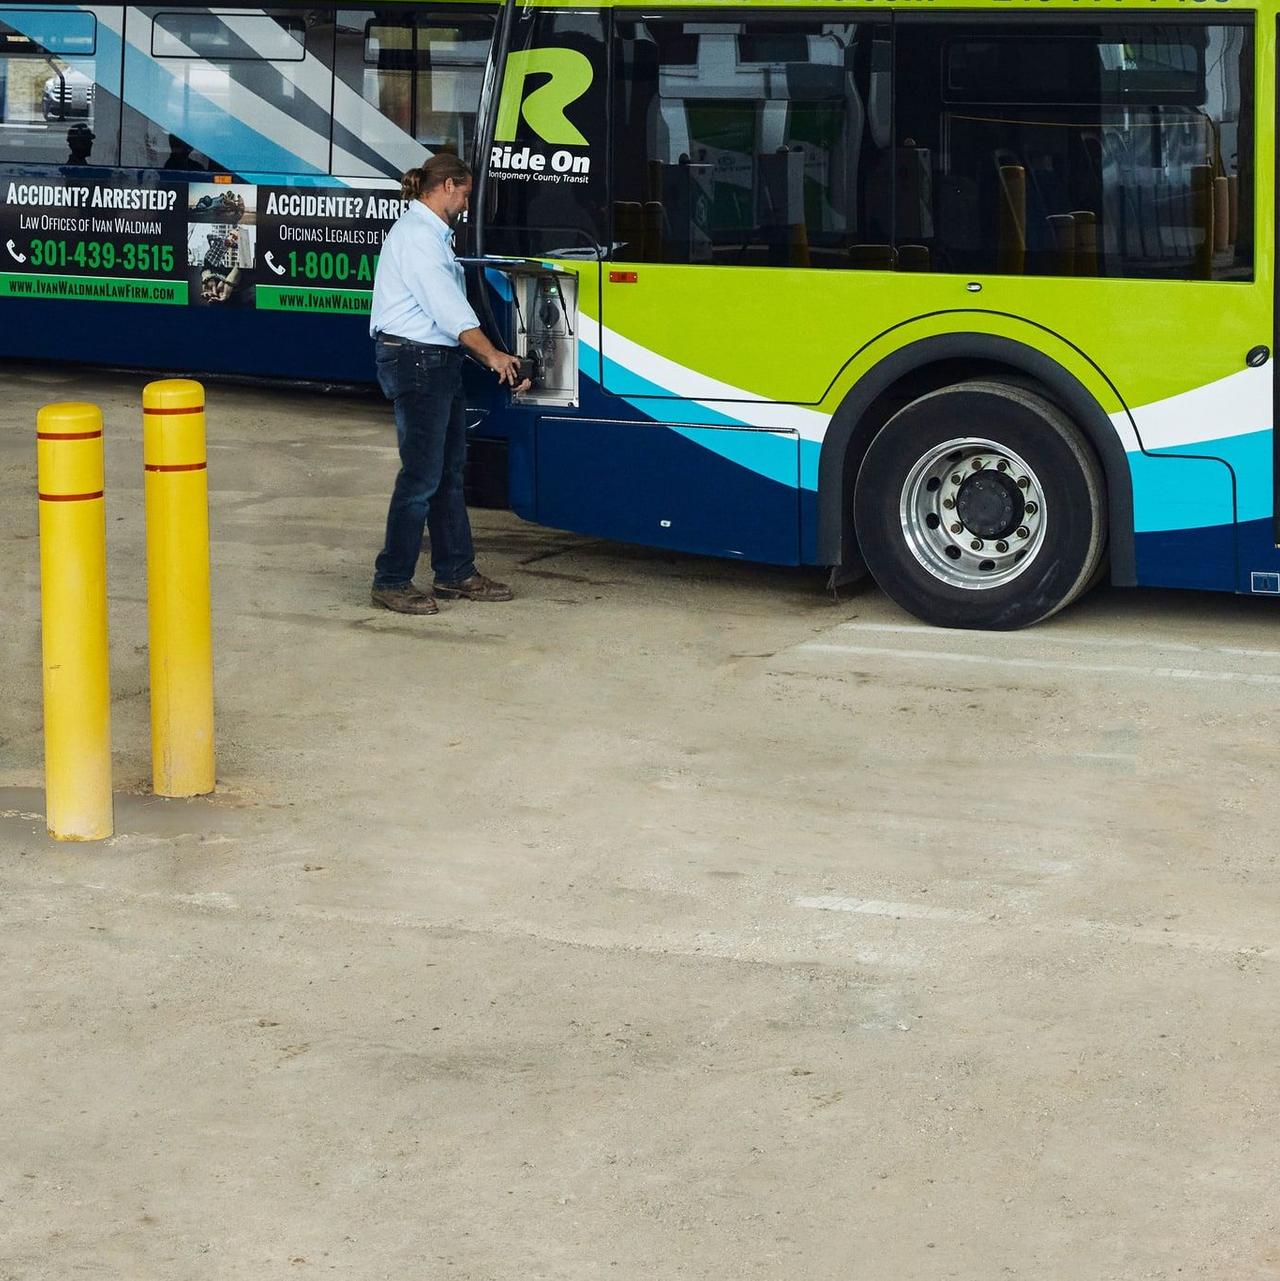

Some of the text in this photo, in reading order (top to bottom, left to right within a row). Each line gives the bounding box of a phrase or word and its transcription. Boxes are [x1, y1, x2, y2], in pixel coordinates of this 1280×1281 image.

[493, 47, 594, 146] R
[489, 146, 591, 174] Ride On
[532, 172, 561, 184] County
[563, 174, 589, 184] Transit
[6, 182, 177, 211] ACCIDENT? ARRESTED?
[266, 192, 364, 219] ACCIDENTE?
[30, 239, 174, 272] 301-439-3515
